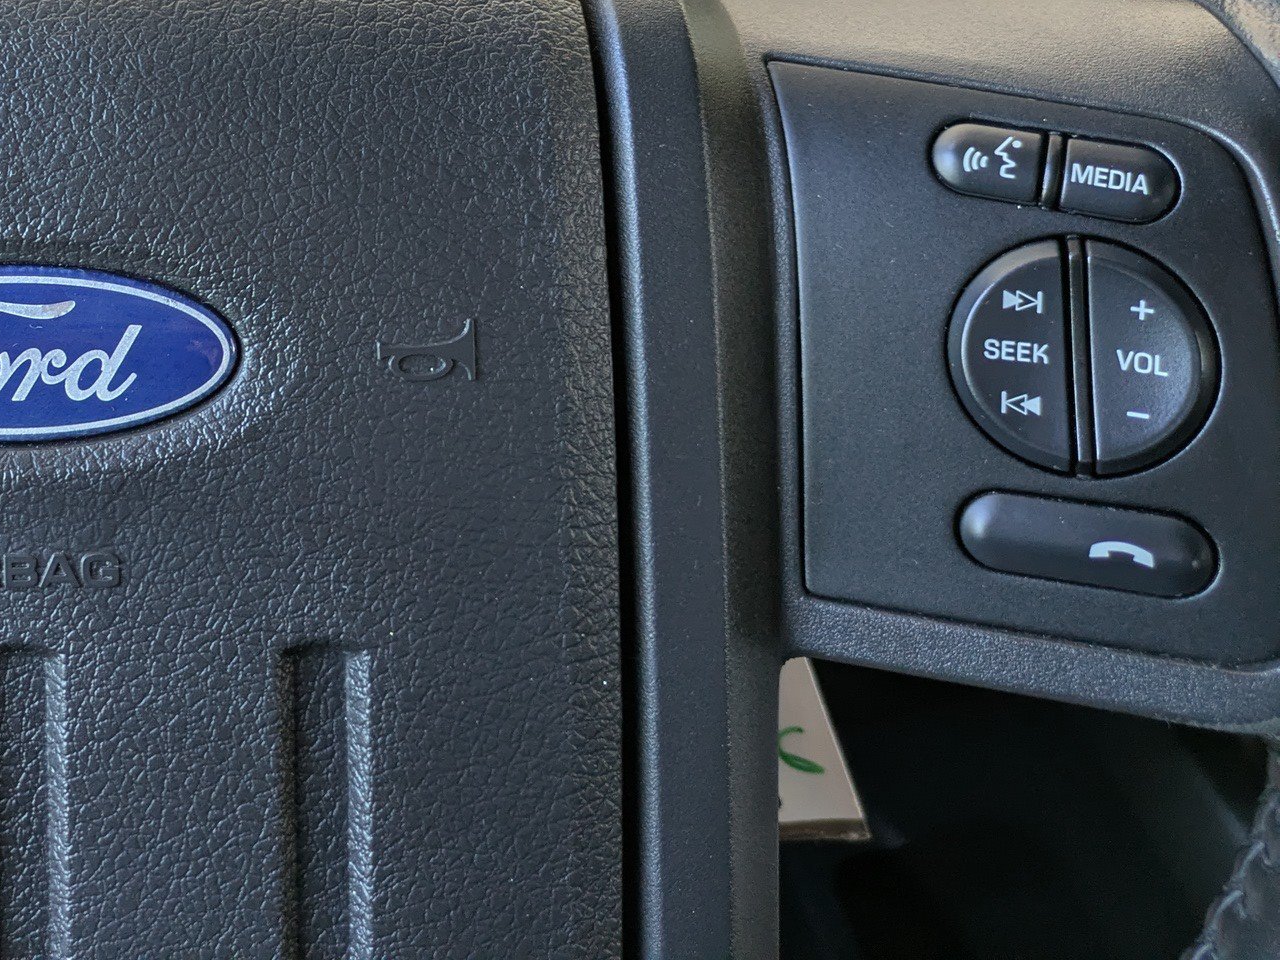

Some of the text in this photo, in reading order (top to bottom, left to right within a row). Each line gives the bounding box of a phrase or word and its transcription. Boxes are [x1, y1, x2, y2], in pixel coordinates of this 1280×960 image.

[1070, 163, 1150, 195] MEDIA
[983, 338, 1050, 365] SEEK
[1116, 349, 1169, 377] VOL
